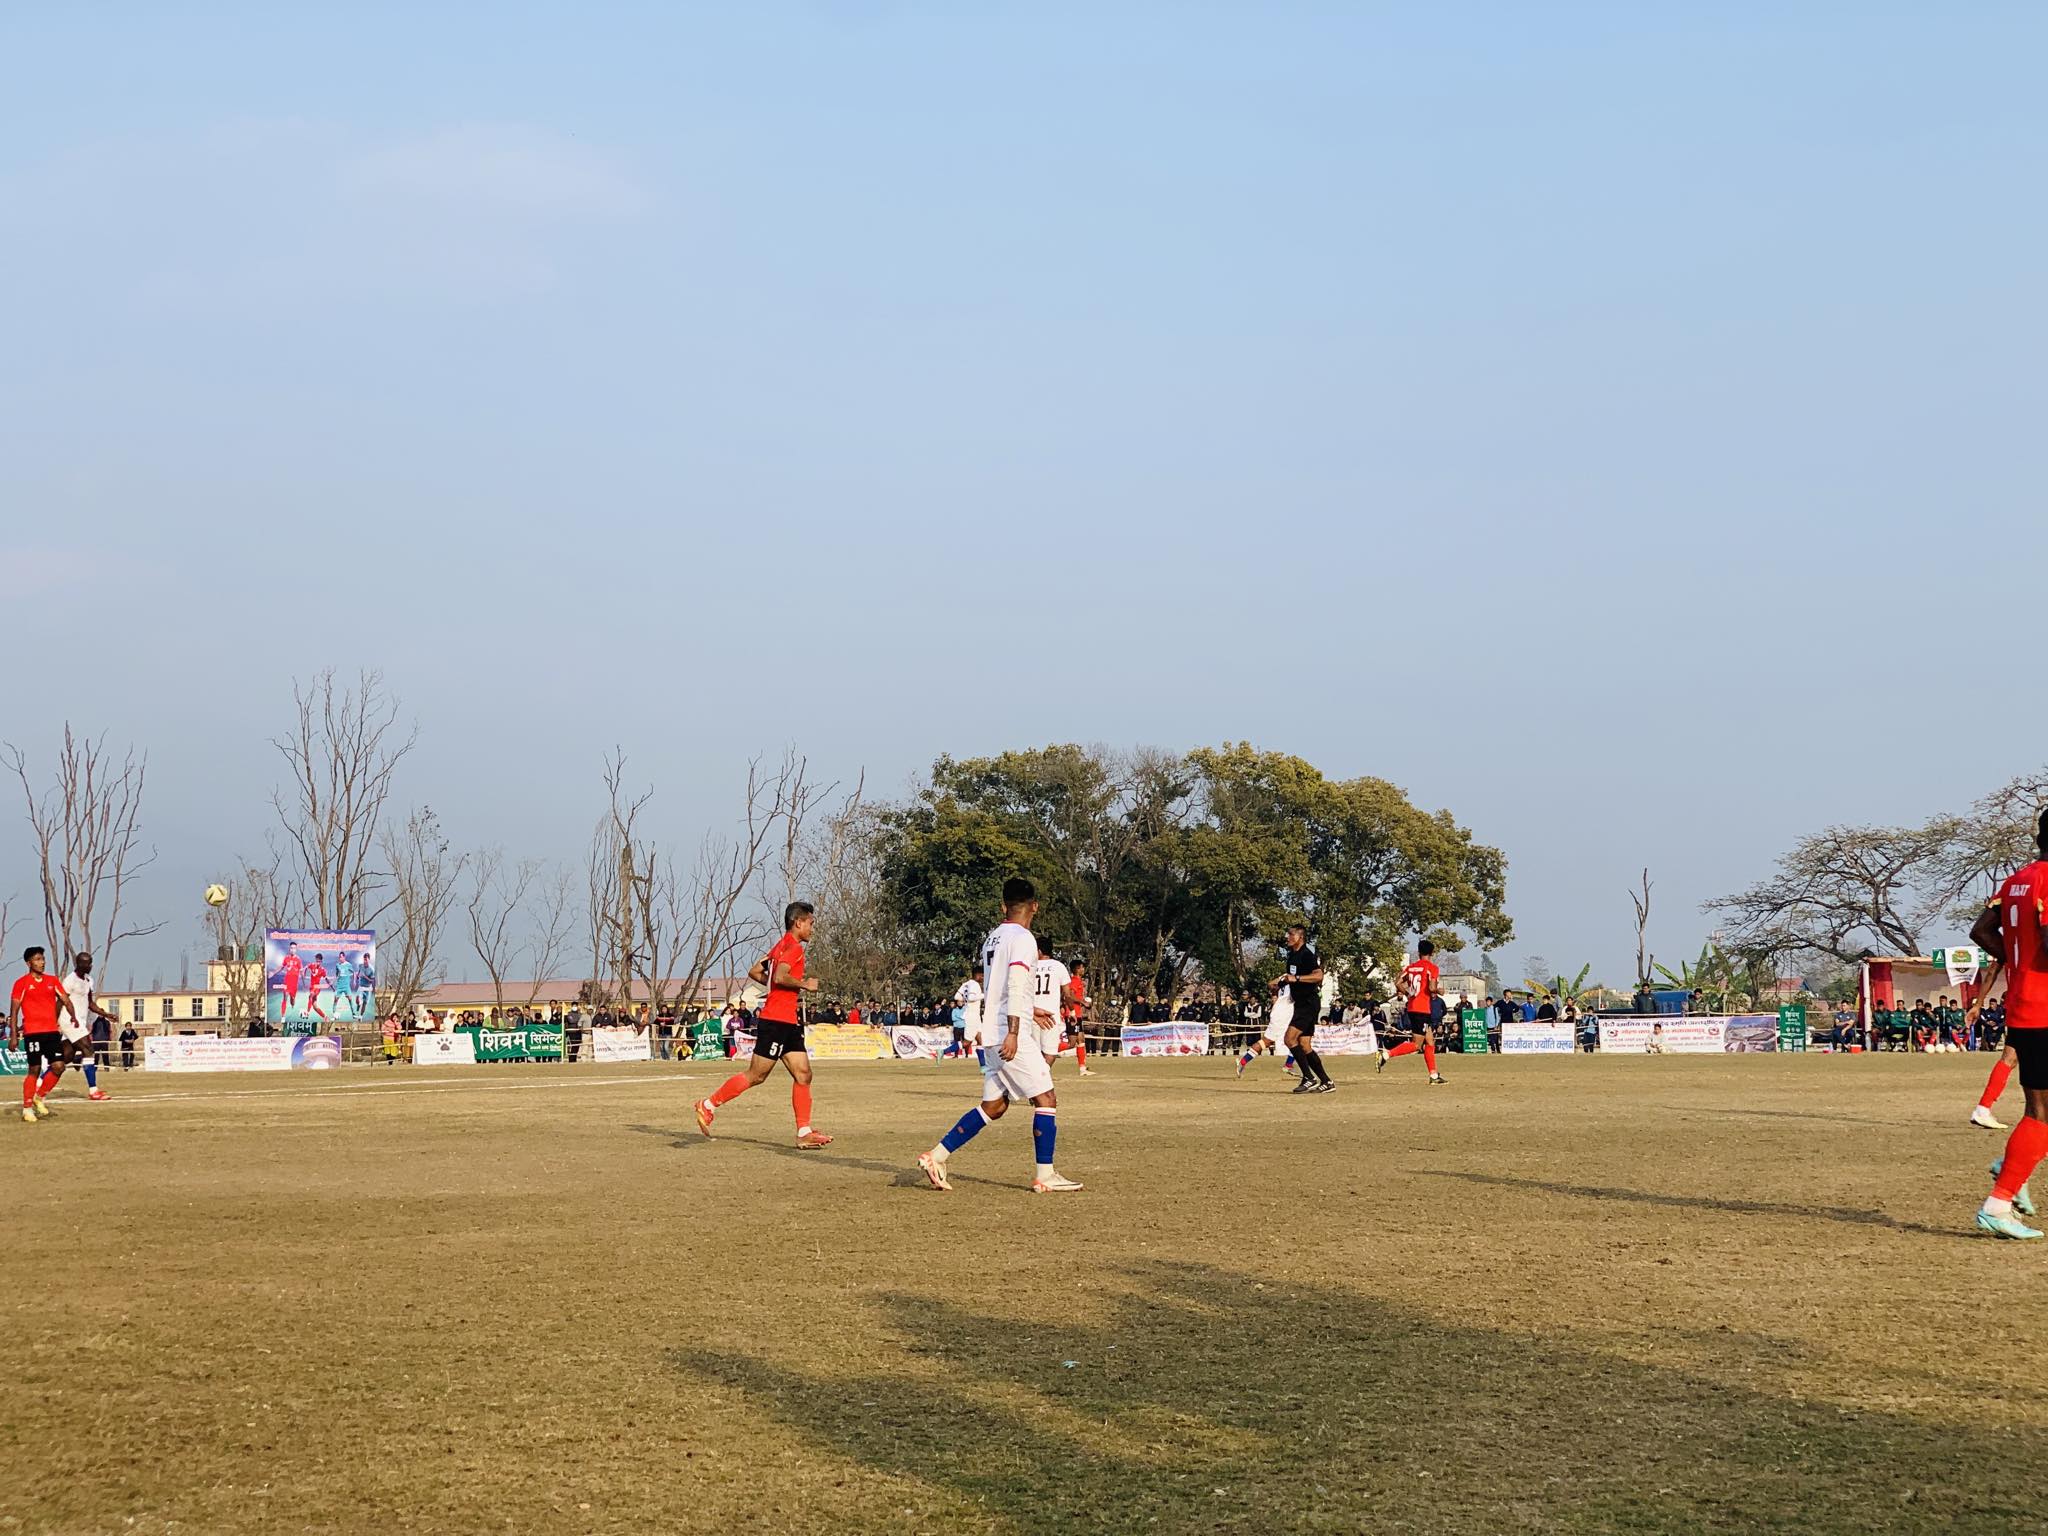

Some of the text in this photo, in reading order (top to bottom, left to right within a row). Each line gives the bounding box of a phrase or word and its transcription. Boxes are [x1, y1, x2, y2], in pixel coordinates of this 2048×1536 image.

[1035, 974, 1051, 995] 11
[28, 1041, 40, 1053] 53
[479, 1028, 531, 1055] शिवम्
[769, 1042, 784, 1057] 51
